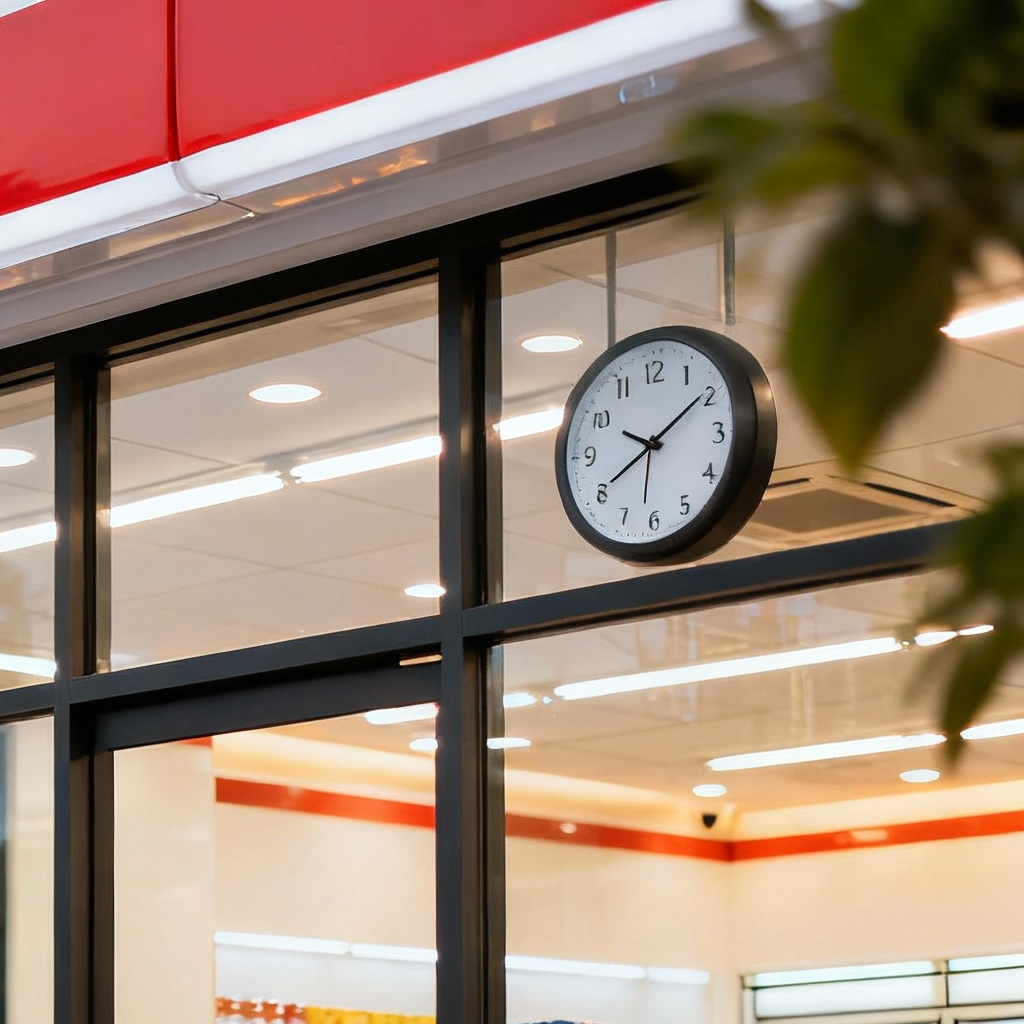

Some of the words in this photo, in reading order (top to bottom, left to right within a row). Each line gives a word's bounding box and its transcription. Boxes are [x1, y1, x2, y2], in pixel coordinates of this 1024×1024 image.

[645, 361, 665, 384] 12
[682, 365, 690, 385] 1
[616, 376, 629, 399] 11
[703, 386, 716, 406] 2
[712, 421, 725, 443] 3
[584, 446, 597, 467] 9
[702, 462, 718, 484] 4
[596, 483, 608, 504] 8
[679, 495, 690, 515] 5
[619, 507, 629, 525] 7
[648, 510, 660, 530] 6
